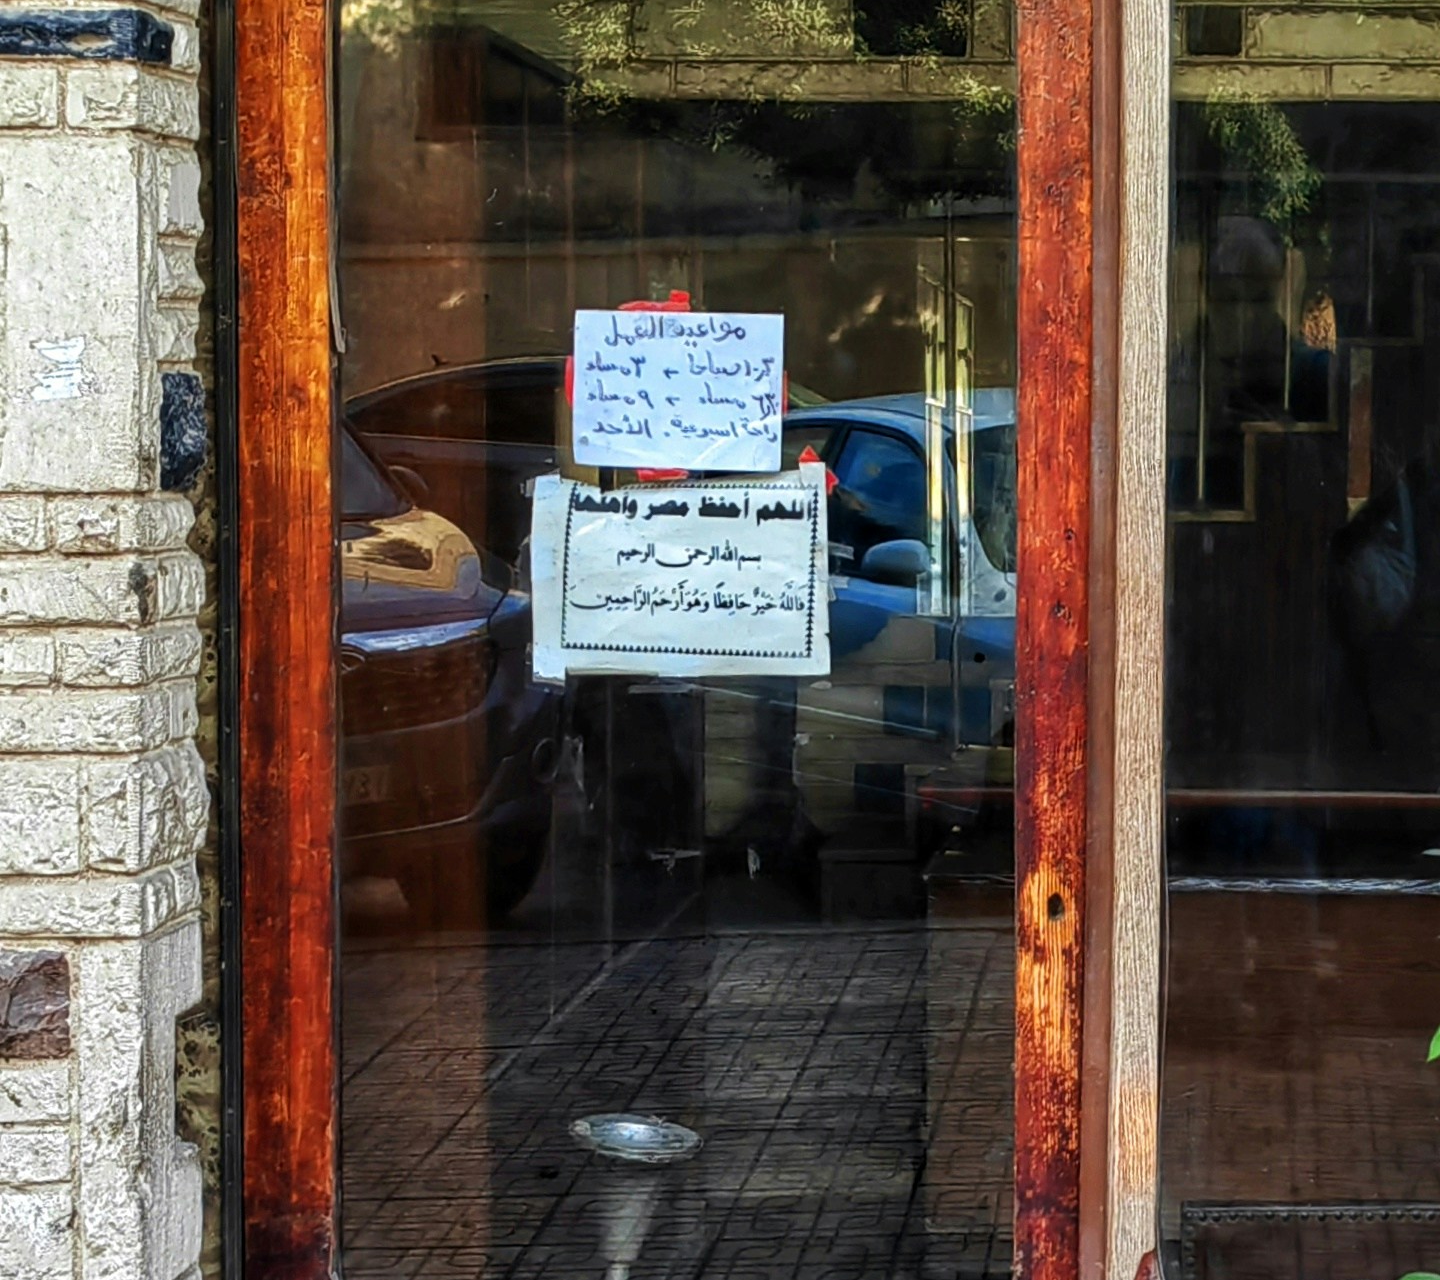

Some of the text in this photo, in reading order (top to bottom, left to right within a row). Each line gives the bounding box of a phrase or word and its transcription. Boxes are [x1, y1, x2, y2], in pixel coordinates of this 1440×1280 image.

[604, 315, 747, 348] مواعيد العمل
[641, 498, 690, 520] مصر
[755, 497, 812, 527] اللهم
[616, 539, 762, 570] بسم الله الرحمن الرحيم
